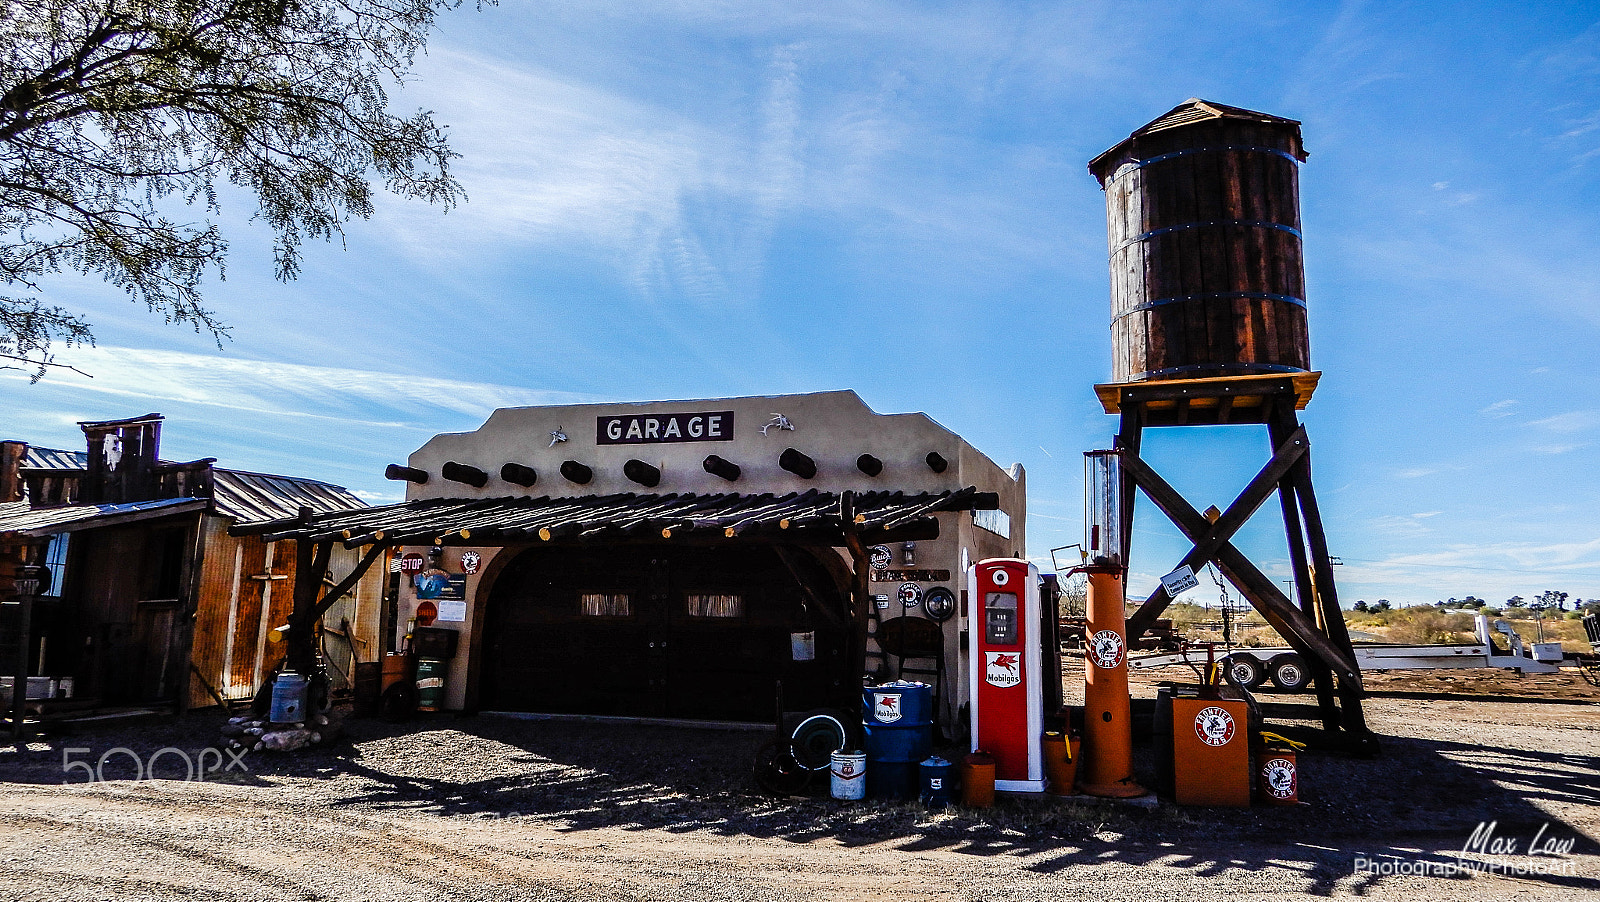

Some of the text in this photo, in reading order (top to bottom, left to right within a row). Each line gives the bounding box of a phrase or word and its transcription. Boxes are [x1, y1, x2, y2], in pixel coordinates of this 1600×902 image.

[607, 416, 722, 440] GARAGE
[401, 558, 423, 570] STOP
[1091, 631, 1123, 648] FRONTIER
[1098, 658, 1118, 668] GAS
[987, 673, 1019, 684] Mobilgas
[1196, 709, 1233, 726] FRONTIER
[1205, 736, 1227, 746] GAS
[1262, 760, 1296, 777] FRONTIER
[1273, 787, 1293, 798] GAS
